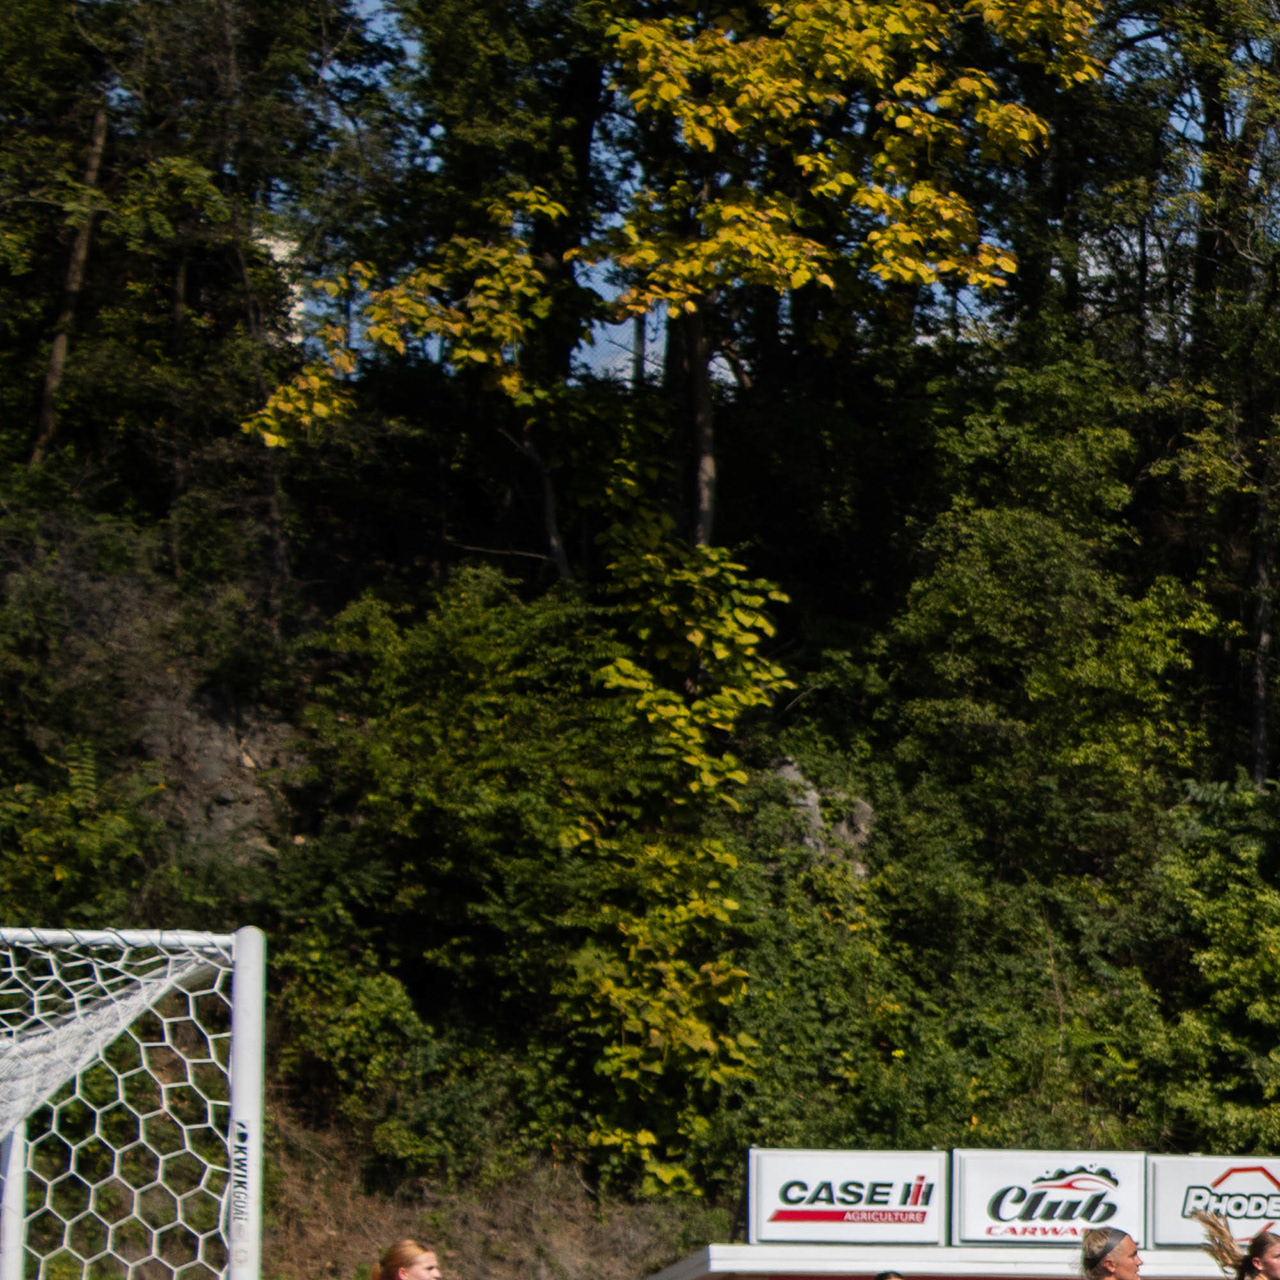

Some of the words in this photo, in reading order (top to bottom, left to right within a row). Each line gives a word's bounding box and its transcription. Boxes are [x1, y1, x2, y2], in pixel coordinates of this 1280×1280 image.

[779, 1180, 894, 1206] CASE
[987, 1186, 1118, 1223] Club
[843, 1211, 924, 1223] AGRICULTURE
[985, 1225, 1086, 1237] CARWA
